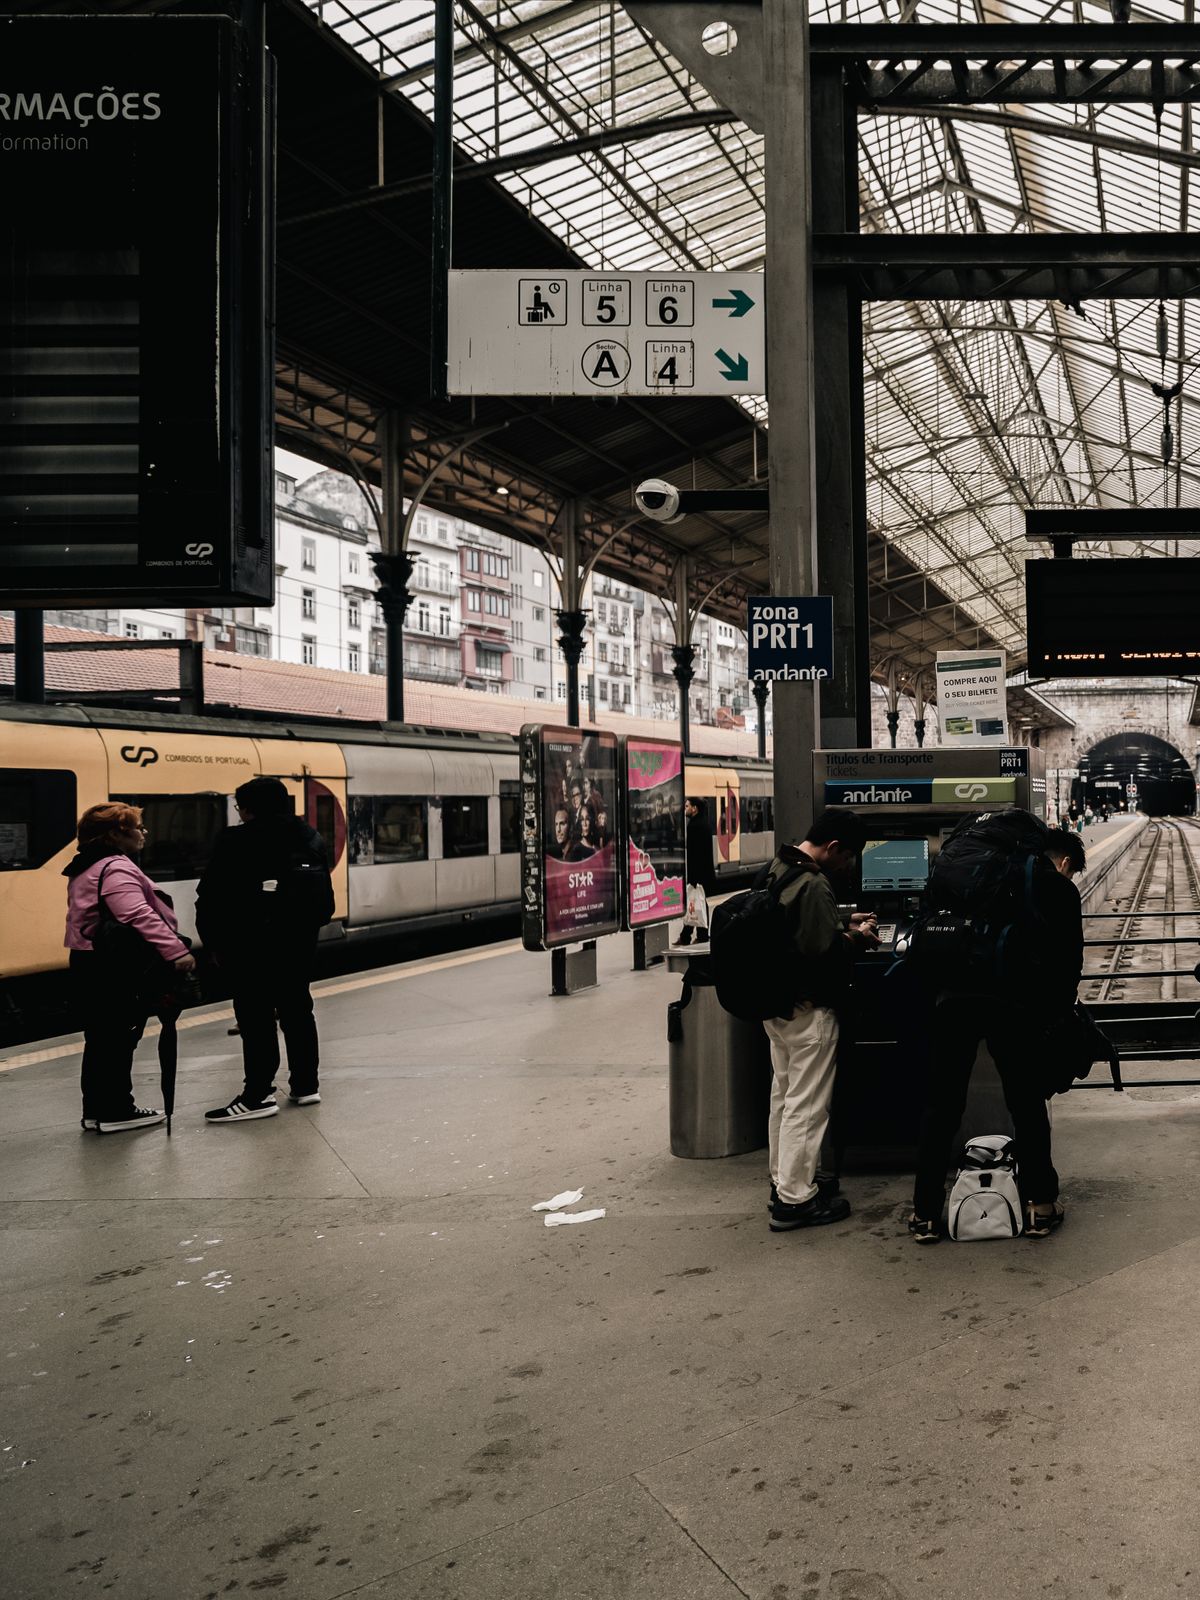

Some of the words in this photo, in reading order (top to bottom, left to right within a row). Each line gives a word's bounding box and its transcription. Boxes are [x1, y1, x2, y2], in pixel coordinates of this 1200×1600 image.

[0, 134, 88, 151] ormation
[589, 283, 622, 292] Linha
[653, 283, 686, 293] Linha
[597, 295, 616, 323] 5
[659, 296, 678, 324] 6
[653, 343, 686, 353] Linha
[592, 350, 620, 378] A
[658, 357, 678, 384] 4
[185, 559, 214, 567] PORTUGAL
[753, 606, 798, 620] zona
[753, 623, 813, 648] PRT1
[754, 664, 828, 680] andante
[944, 677, 976, 686] COMPRE
[979, 676, 997, 684] AQUI
[968, 688, 998, 697] BILHETE
[165, 754, 202, 763] COMBOIOS
[205, 756, 213, 764] DE
[216, 756, 250, 765] PORTUGAL
[825, 753, 859, 765] Títulos
[862, 753, 875, 764] de
[879, 753, 933, 765] Transporte
[1001, 758, 1021, 767] PRT1
[826, 765, 858, 777] Tickets
[842, 785, 912, 803] andante
